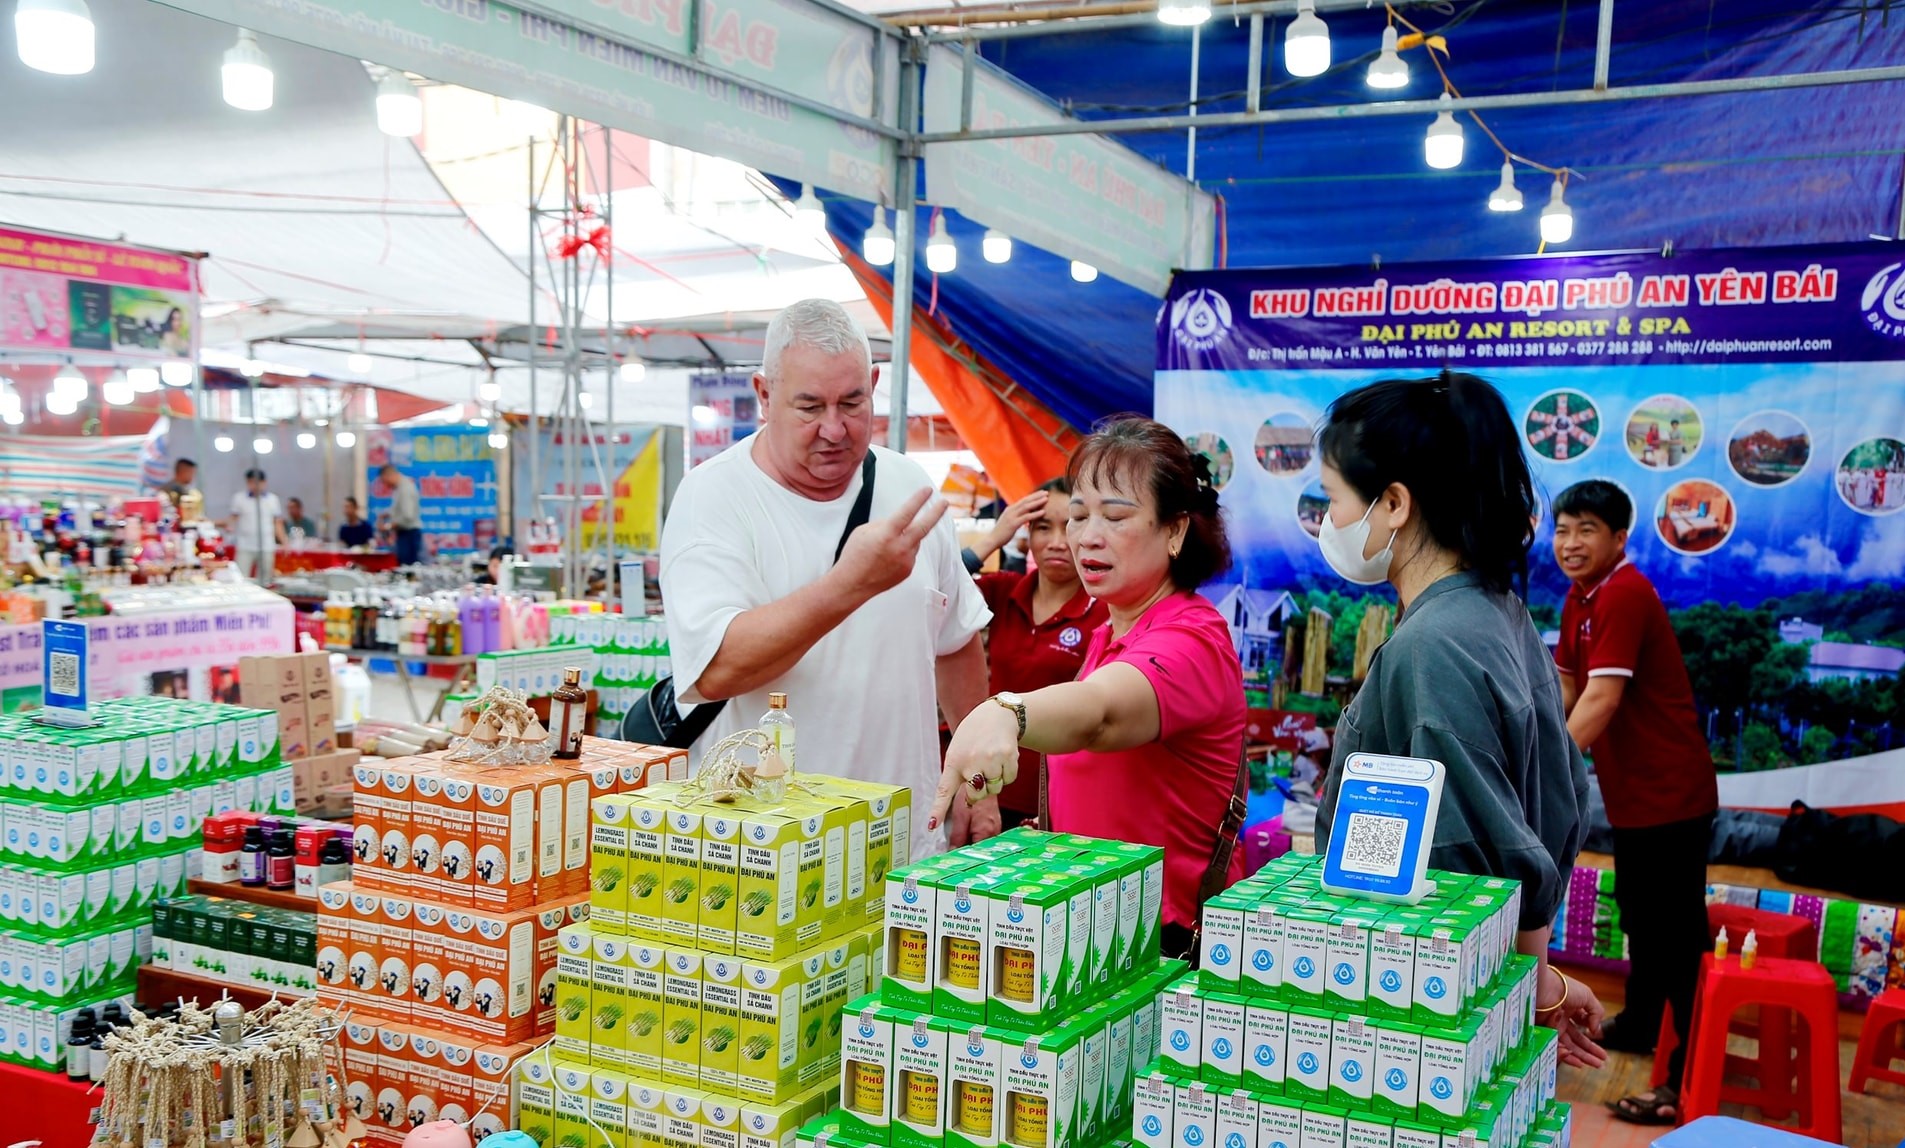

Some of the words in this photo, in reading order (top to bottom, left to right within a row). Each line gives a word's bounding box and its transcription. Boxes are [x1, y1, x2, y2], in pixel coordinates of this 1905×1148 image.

[1250, 289, 1310, 319] KHU
[1312, 278, 1388, 316] NGHỈ
[1391, 279, 1497, 317] DƯỠNG
[1502, 277, 1558, 317] ĐẠI
[1563, 271, 1633, 310] PHÚ
[1636, 275, 1690, 308] AN
[1695, 267, 1767, 307] YÊN
[1771, 264, 1838, 304] BÁI
[1361, 324, 1404, 345] ĐẠI
[1409, 319, 1463, 341] PHÚ
[1466, 322, 1504, 340] AN
[1508, 318, 1611, 339] RESORT
[1615, 316, 1632, 335] &
[1638, 316, 1692, 335] SPA
[1334, 348, 1343, 360] A
[1495, 343, 1523, 357] 0813
[1524, 343, 1544, 357] 381
[1576, 341, 1605, 356] 0377
[1607, 341, 1630, 355] 288
[747, 848, 759, 857] TINH
[653, 855, 662, 864] AN
[689, 860, 698, 869] AN
[754, 857, 772, 867] CHANH
[727, 867, 736, 875] AN
[766, 872, 775, 882] AN
[748, 992, 760, 1001] TINH
[754, 1000, 773, 1010] CHANH
[767, 1016, 777, 1026] AN
